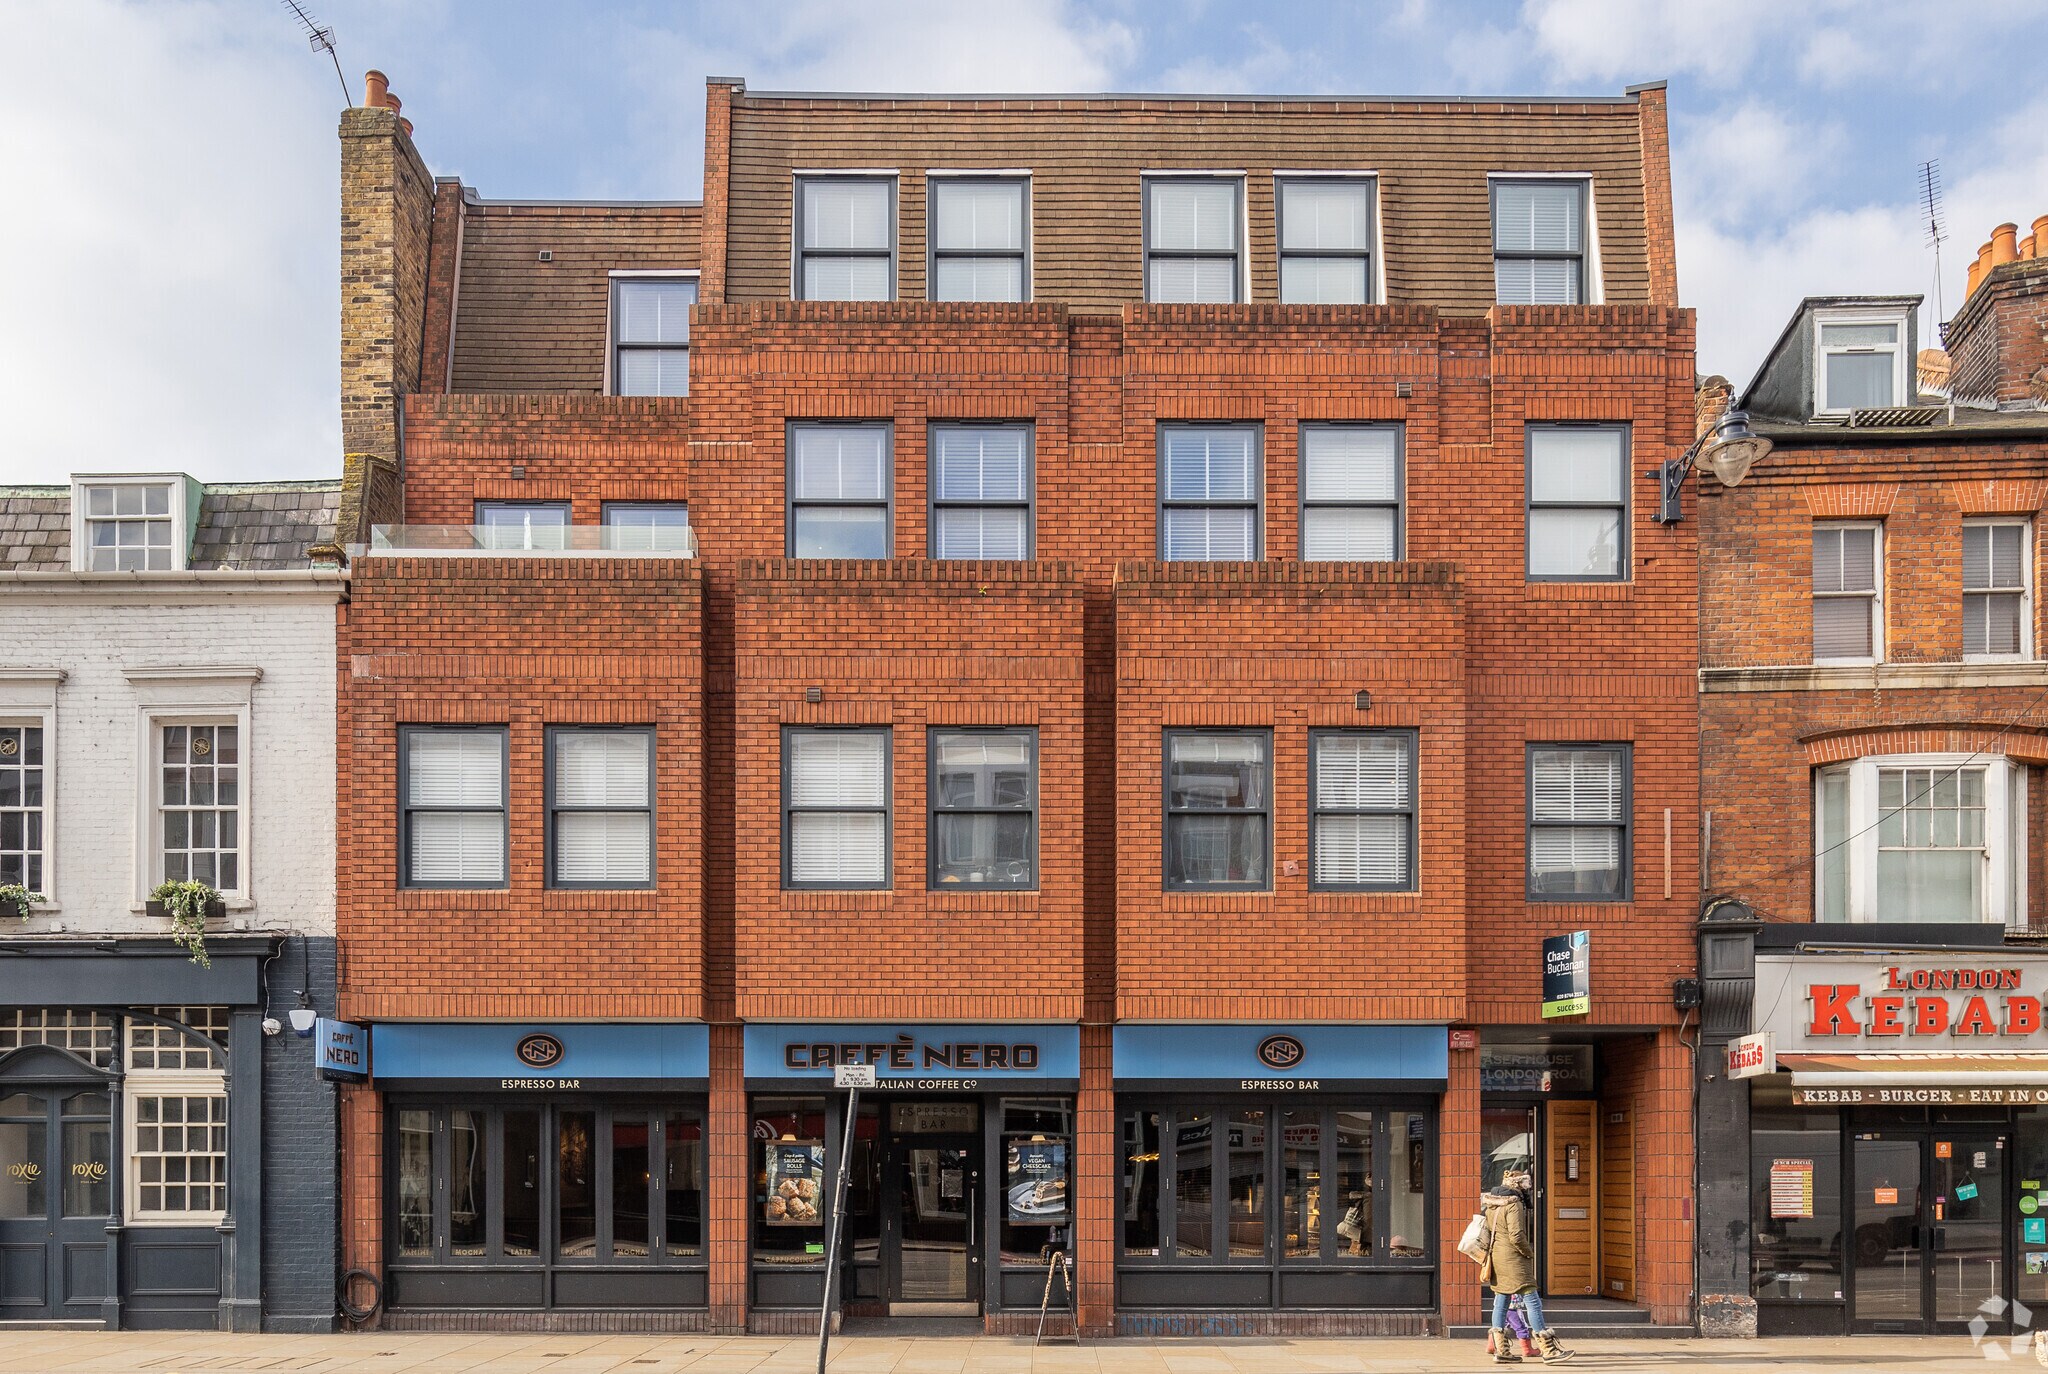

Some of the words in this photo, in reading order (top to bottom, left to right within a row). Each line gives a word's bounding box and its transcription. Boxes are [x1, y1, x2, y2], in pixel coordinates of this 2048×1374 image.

[1547, 950, 1570, 963] Chase
[1547, 960, 1584, 974] Buchanan
[1884, 967, 2023, 989] LONDON
[1556, 1003, 1584, 1013] success
[1806, 984, 2048, 1036] KEBAB
[1737, 1042, 1755, 1052] LONDON
[326, 1045, 359, 1065] NERO
[922, 1043, 1040, 1070] NERO
[1482, 1054, 1520, 1065] ASER
[1525, 1054, 1574, 1065] HOUSE
[1729, 1044, 1763, 1070] KEBABS
[501, 1079, 555, 1089] ESPRESSO
[559, 1079, 580, 1089] BAR
[875, 1080, 914, 1089] TALIAN
[918, 1079, 959, 1090] COFFEE
[1241, 1080, 1295, 1090] ESPRESSO
[1298, 1080, 1319, 1090] BAR
[1803, 1090, 1863, 1102] KEBAB
[1880, 1090, 1951, 1102] BURGER
[1969, 1090, 2003, 1102] EAT
[2008, 1090, 2030, 1102] IN
[898, 1106, 969, 1117] ESPRESSO
[921, 1120, 947, 1130] BAR
[7, 1162, 42, 1180] roxie
[72, 1161, 108, 1180] roxie
[455, 1248, 484, 1256] MOCHA
[510, 1248, 532, 1256] LATTE
[617, 1248, 646, 1256] MOCHA
[674, 1248, 695, 1256] LATTE
[1179, 1248, 1209, 1256] MOCHA
